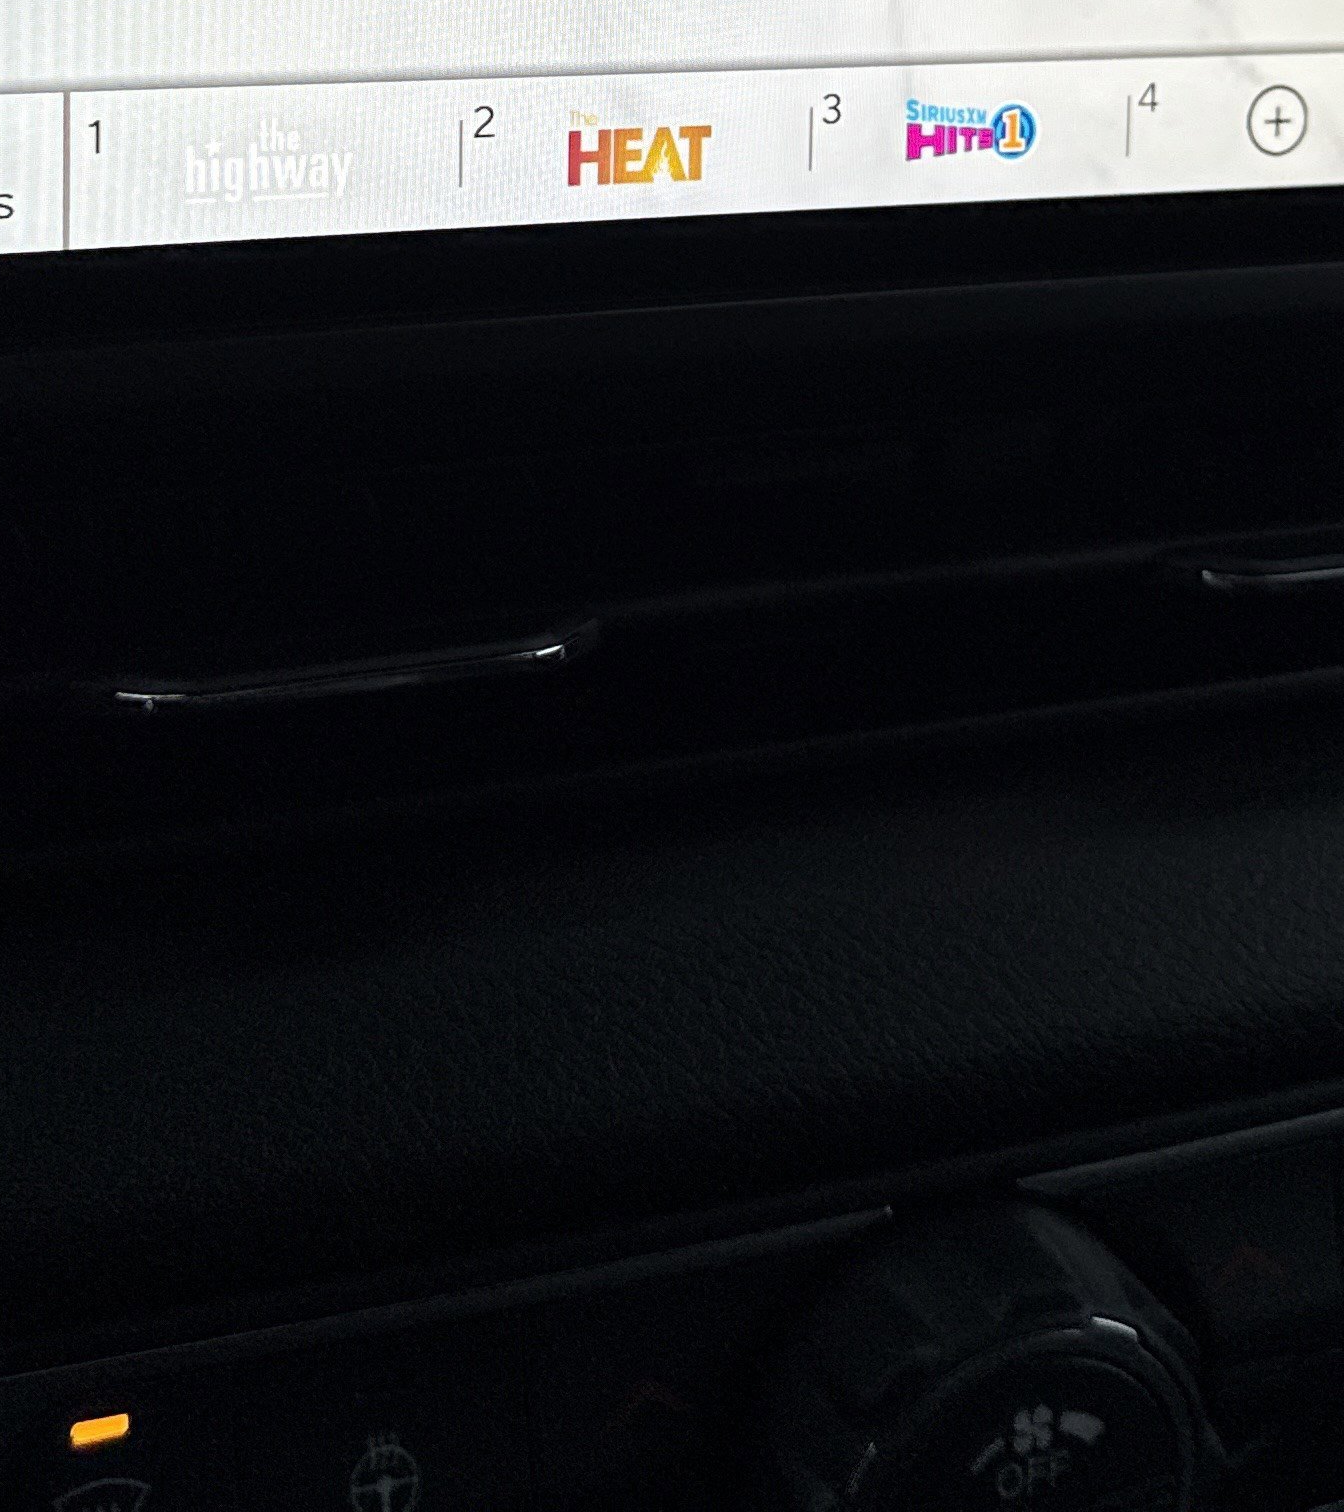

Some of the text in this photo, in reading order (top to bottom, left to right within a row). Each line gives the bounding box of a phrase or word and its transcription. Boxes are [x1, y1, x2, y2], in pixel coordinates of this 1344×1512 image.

[821, 92, 843, 126] 3
[1137, 82, 1160, 113] 4
[87, 119, 102, 156] 1
[259, 118, 302, 152] the
[472, 104, 496, 140] 2
[567, 124, 713, 187] HEAT
[905, 122, 994, 161] HITS
[185, 144, 354, 200] highway
[995, 1448, 1072, 1500] OFF
